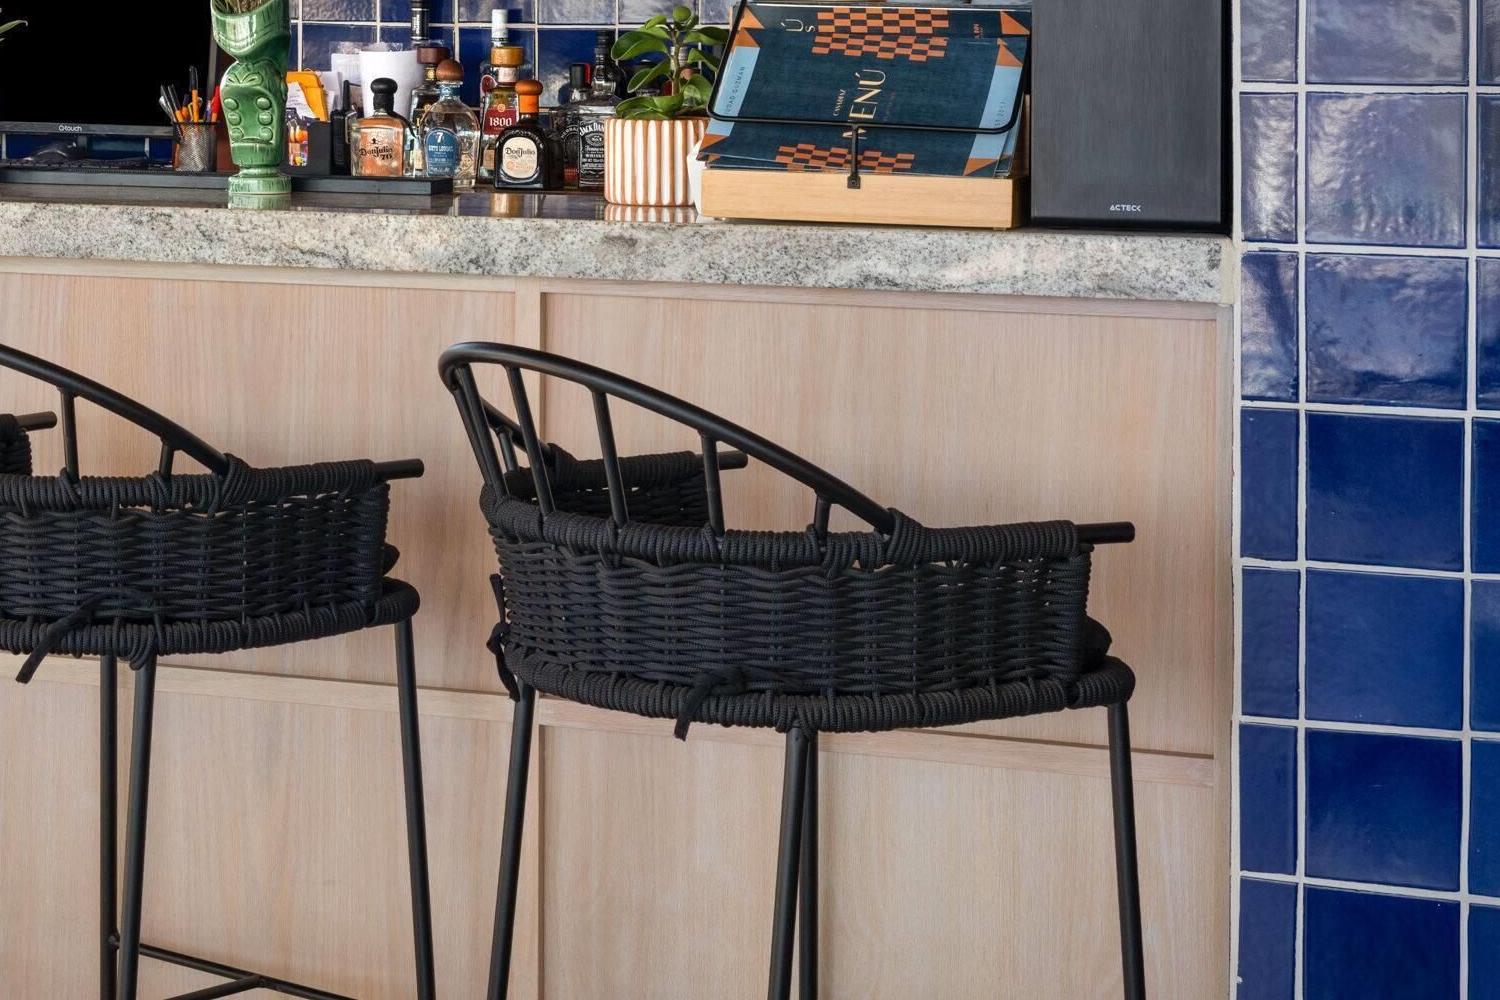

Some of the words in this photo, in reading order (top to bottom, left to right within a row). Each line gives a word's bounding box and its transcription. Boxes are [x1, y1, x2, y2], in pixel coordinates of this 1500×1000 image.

[489, 116, 513, 127] 1800
[436, 132, 443, 143] 7
[1109, 204, 1141, 212] ACTECK
